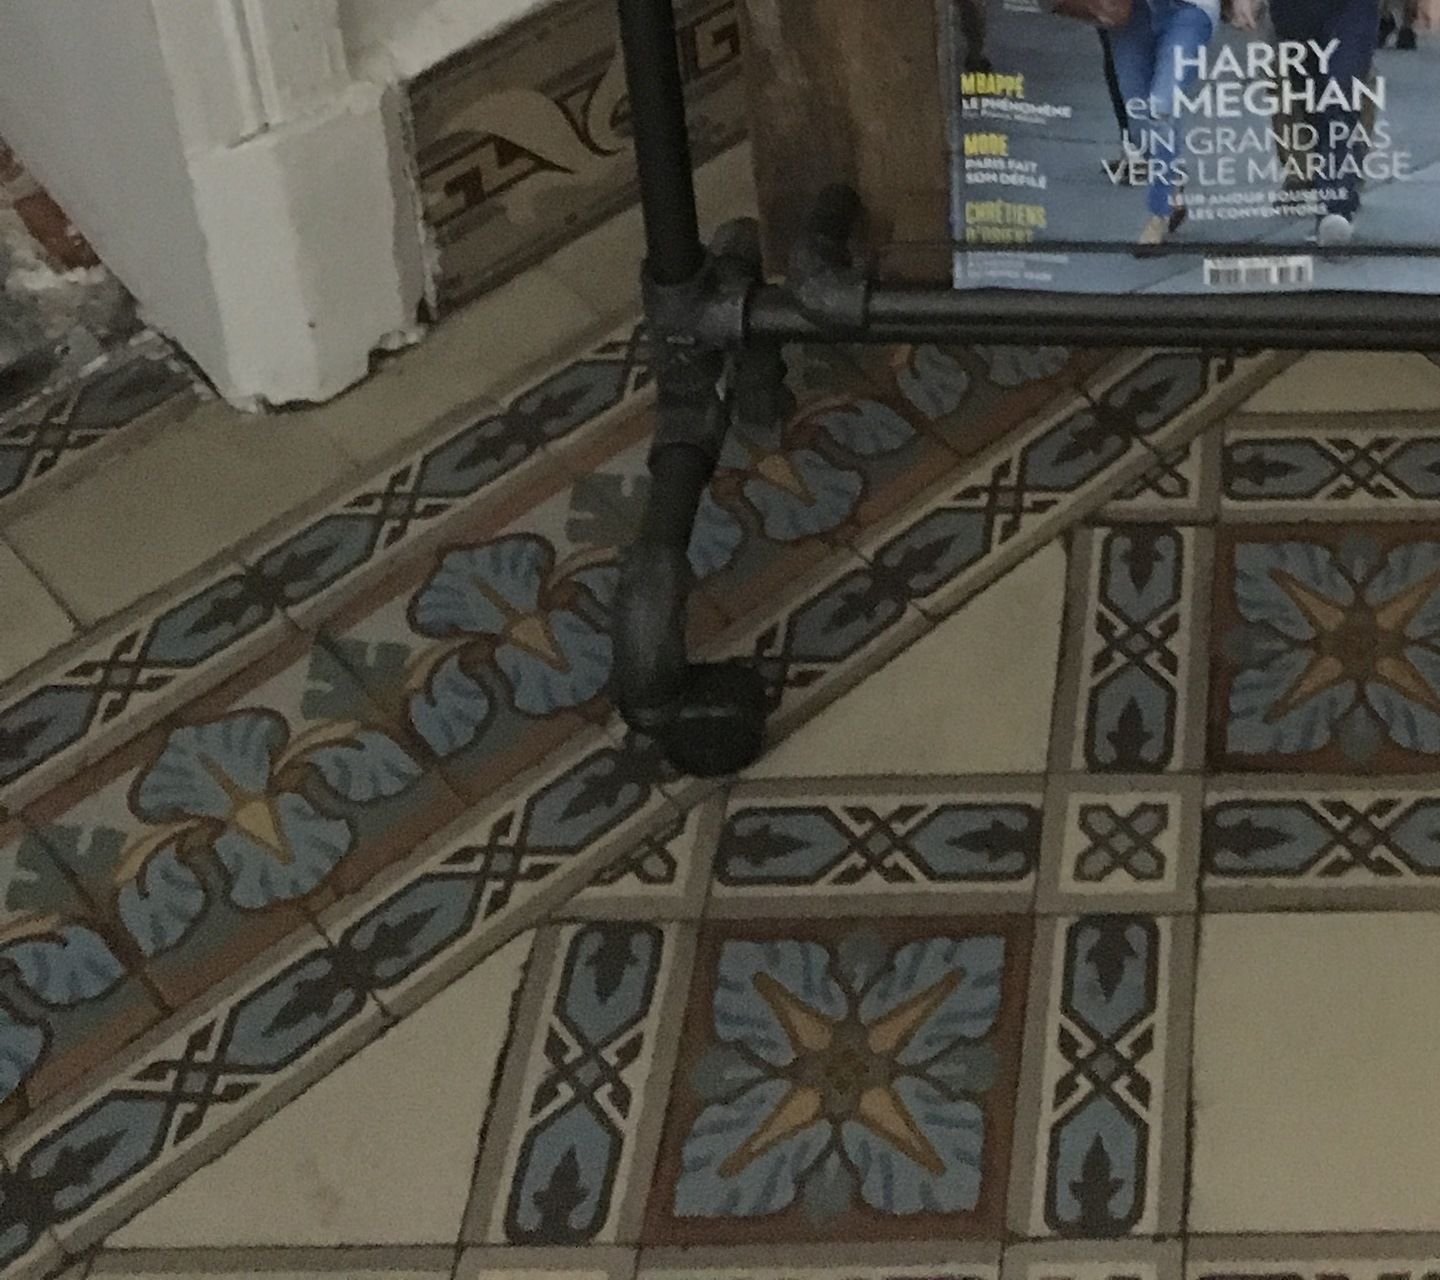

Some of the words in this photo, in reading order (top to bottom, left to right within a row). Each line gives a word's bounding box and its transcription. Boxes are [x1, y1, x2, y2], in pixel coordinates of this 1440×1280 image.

[1172, 38, 1341, 82] HARRY
[1125, 92, 1162, 121] et
[1171, 74, 1386, 120] MEGHAN
[1121, 127, 1176, 158] UN
[1184, 121, 1320, 157] GRAND
[1328, 119, 1393, 151] PAS
[1100, 156, 1190, 188] VERS
[1197, 156, 1237, 187] LE
[1246, 150, 1412, 185] MARIAGE
[1187, 204, 1217, 221] LES
